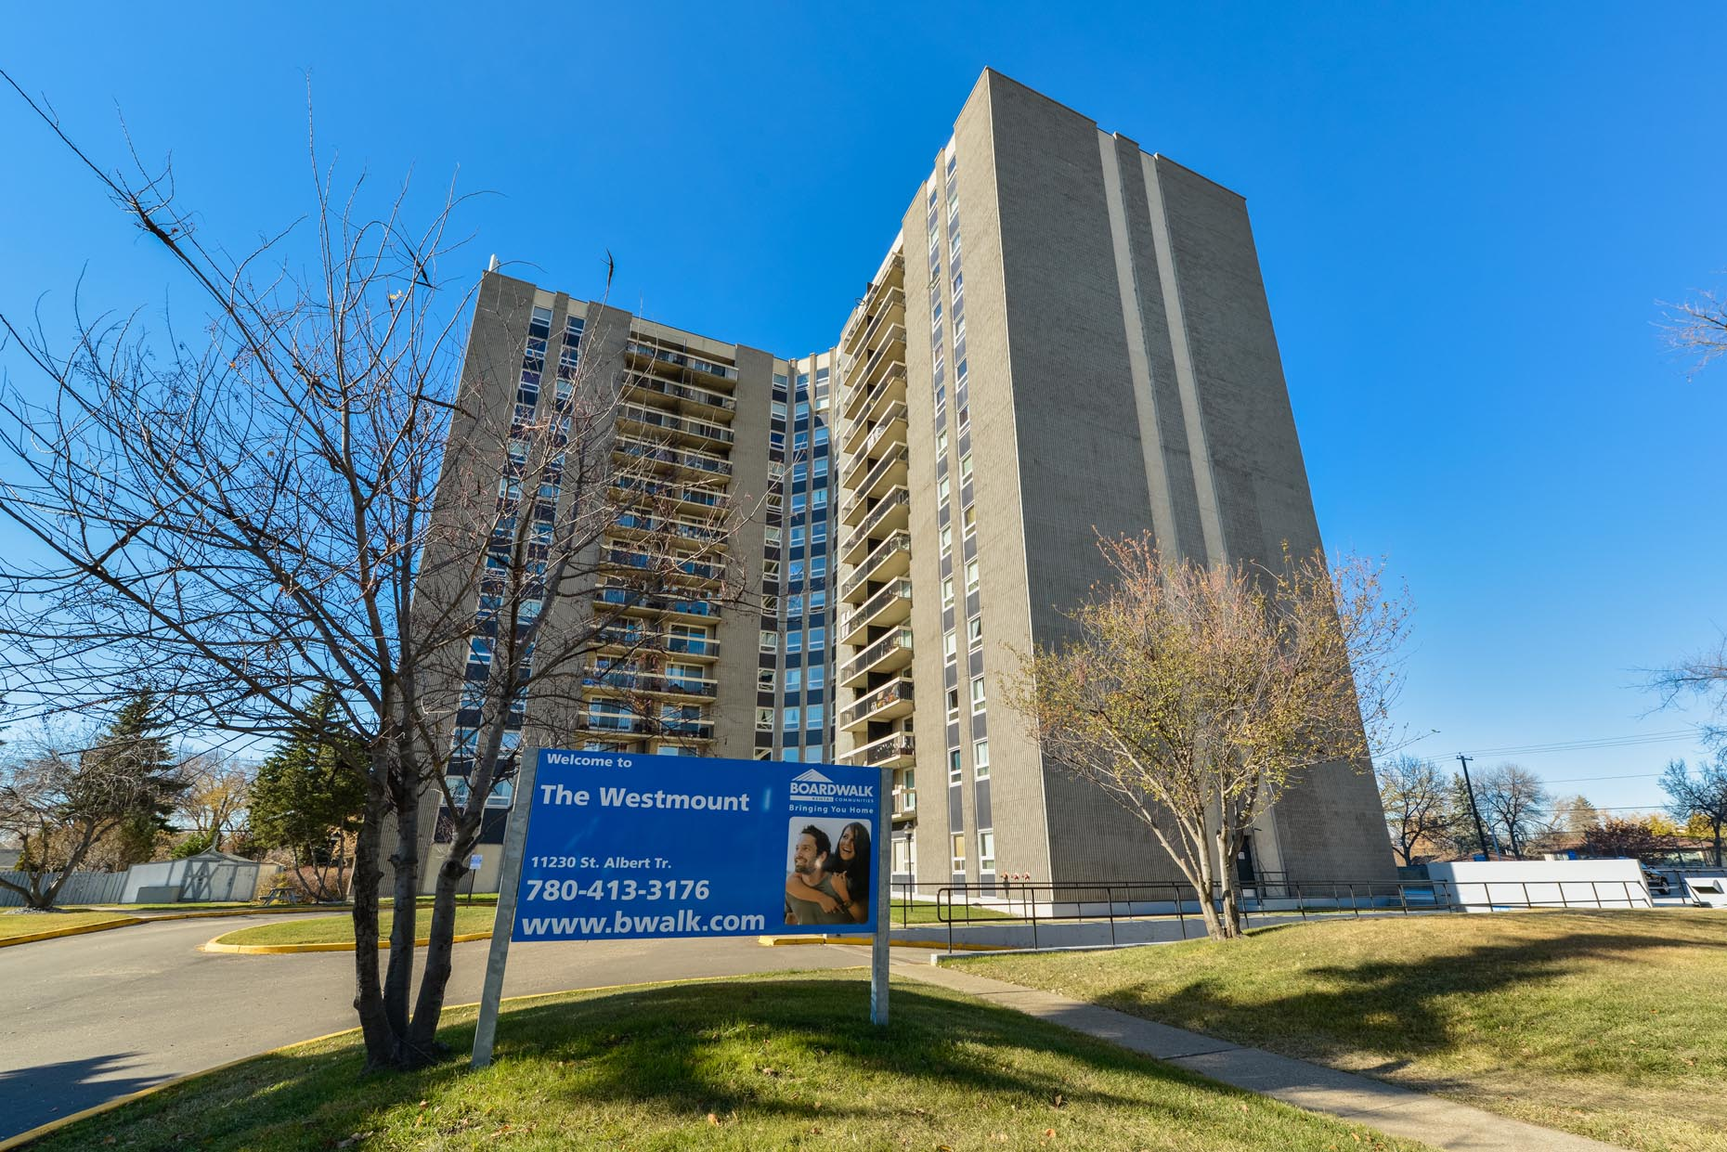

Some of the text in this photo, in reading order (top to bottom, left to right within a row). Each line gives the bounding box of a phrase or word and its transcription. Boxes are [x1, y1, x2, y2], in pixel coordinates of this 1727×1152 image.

[547, 753, 632, 768] Welcome to
[789, 782, 874, 797] BOARDWALK
[540, 784, 750, 812] The Westmount
[789, 804, 828, 814] Bringing
[831, 805, 847, 813] You
[531, 856, 672, 869] 11230 St. Albert Tr.
[526, 879, 710, 901] 780-413-3176
[522, 909, 766, 935] www.bwalk.com
